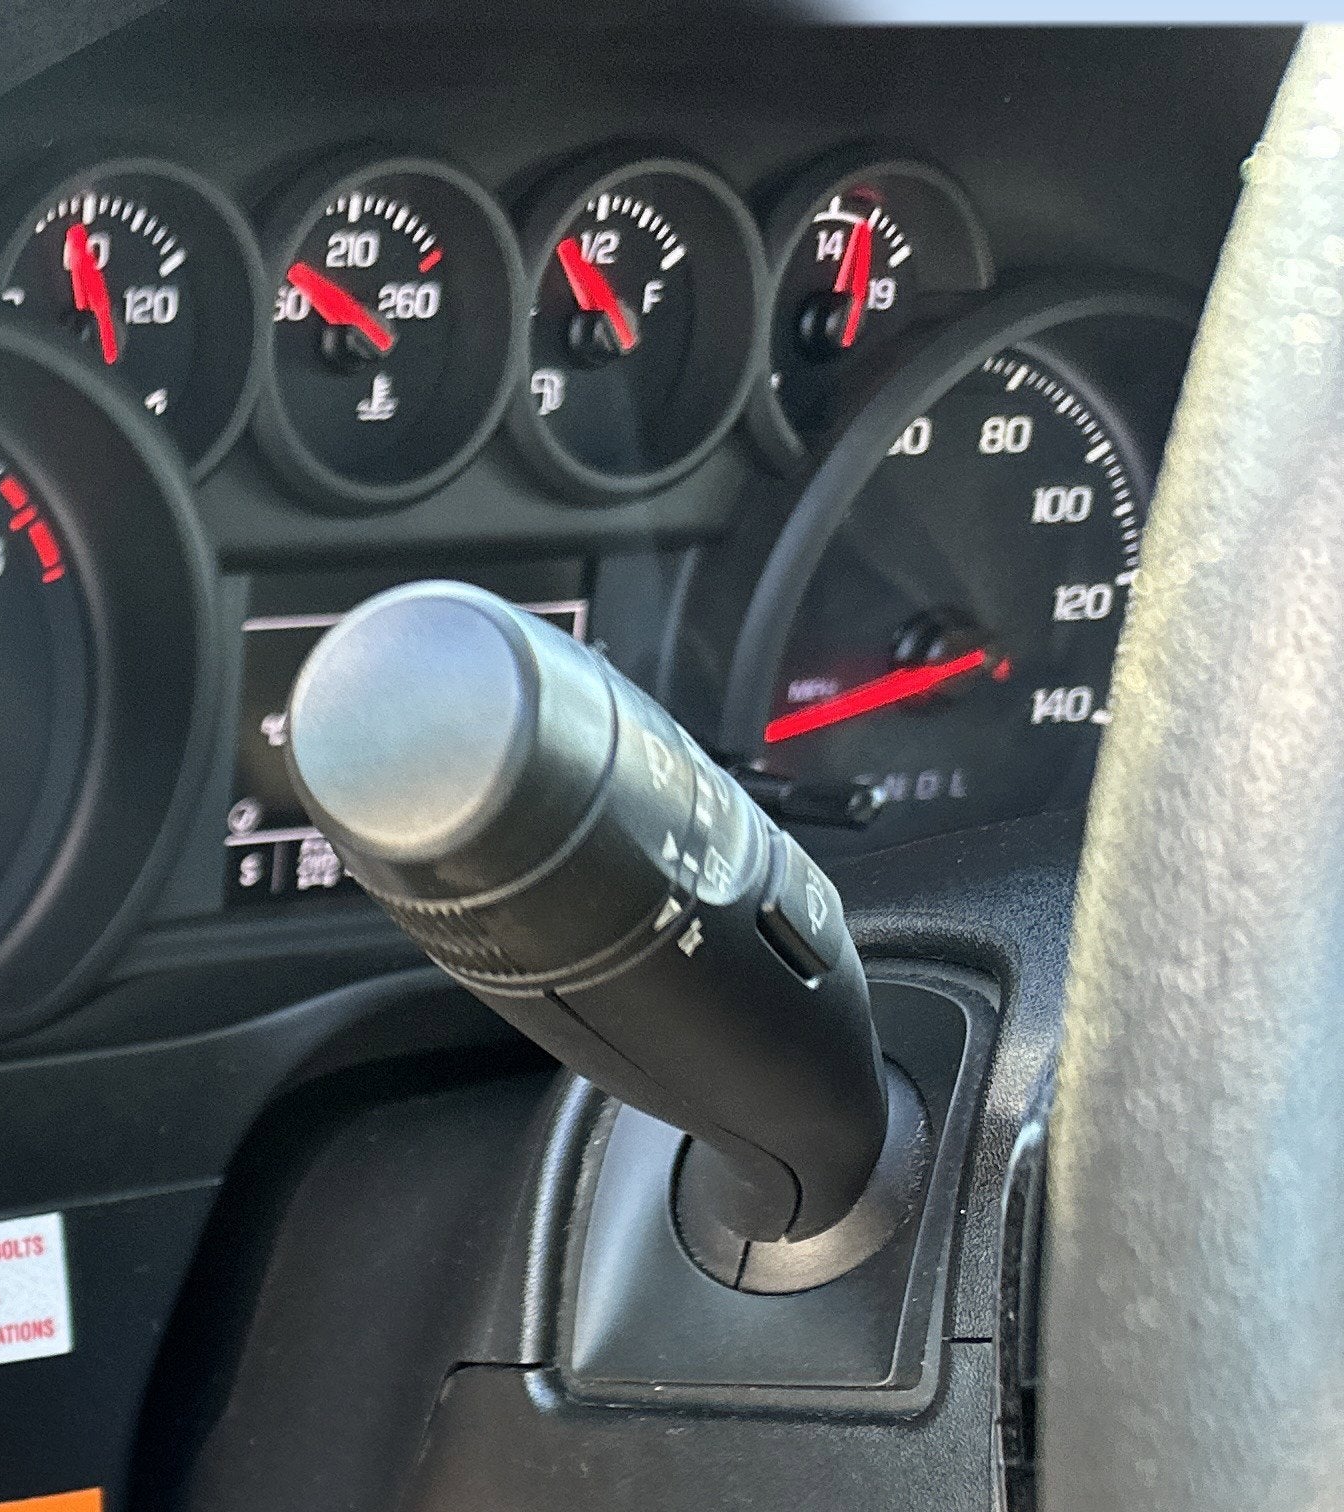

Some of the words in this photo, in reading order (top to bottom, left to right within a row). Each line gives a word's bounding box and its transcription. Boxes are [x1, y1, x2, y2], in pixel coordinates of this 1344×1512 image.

[326, 229, 381, 268] 210
[816, 229, 844, 262] 14
[123, 285, 179, 324] 120
[378, 282, 442, 320] 260
[643, 280, 665, 313] F
[867, 278, 897, 311] 19
[979, 416, 1031, 456] 80
[1030, 485, 1092, 526] 100
[1052, 582, 1113, 622] 120
[1030, 685, 1095, 725] 140
